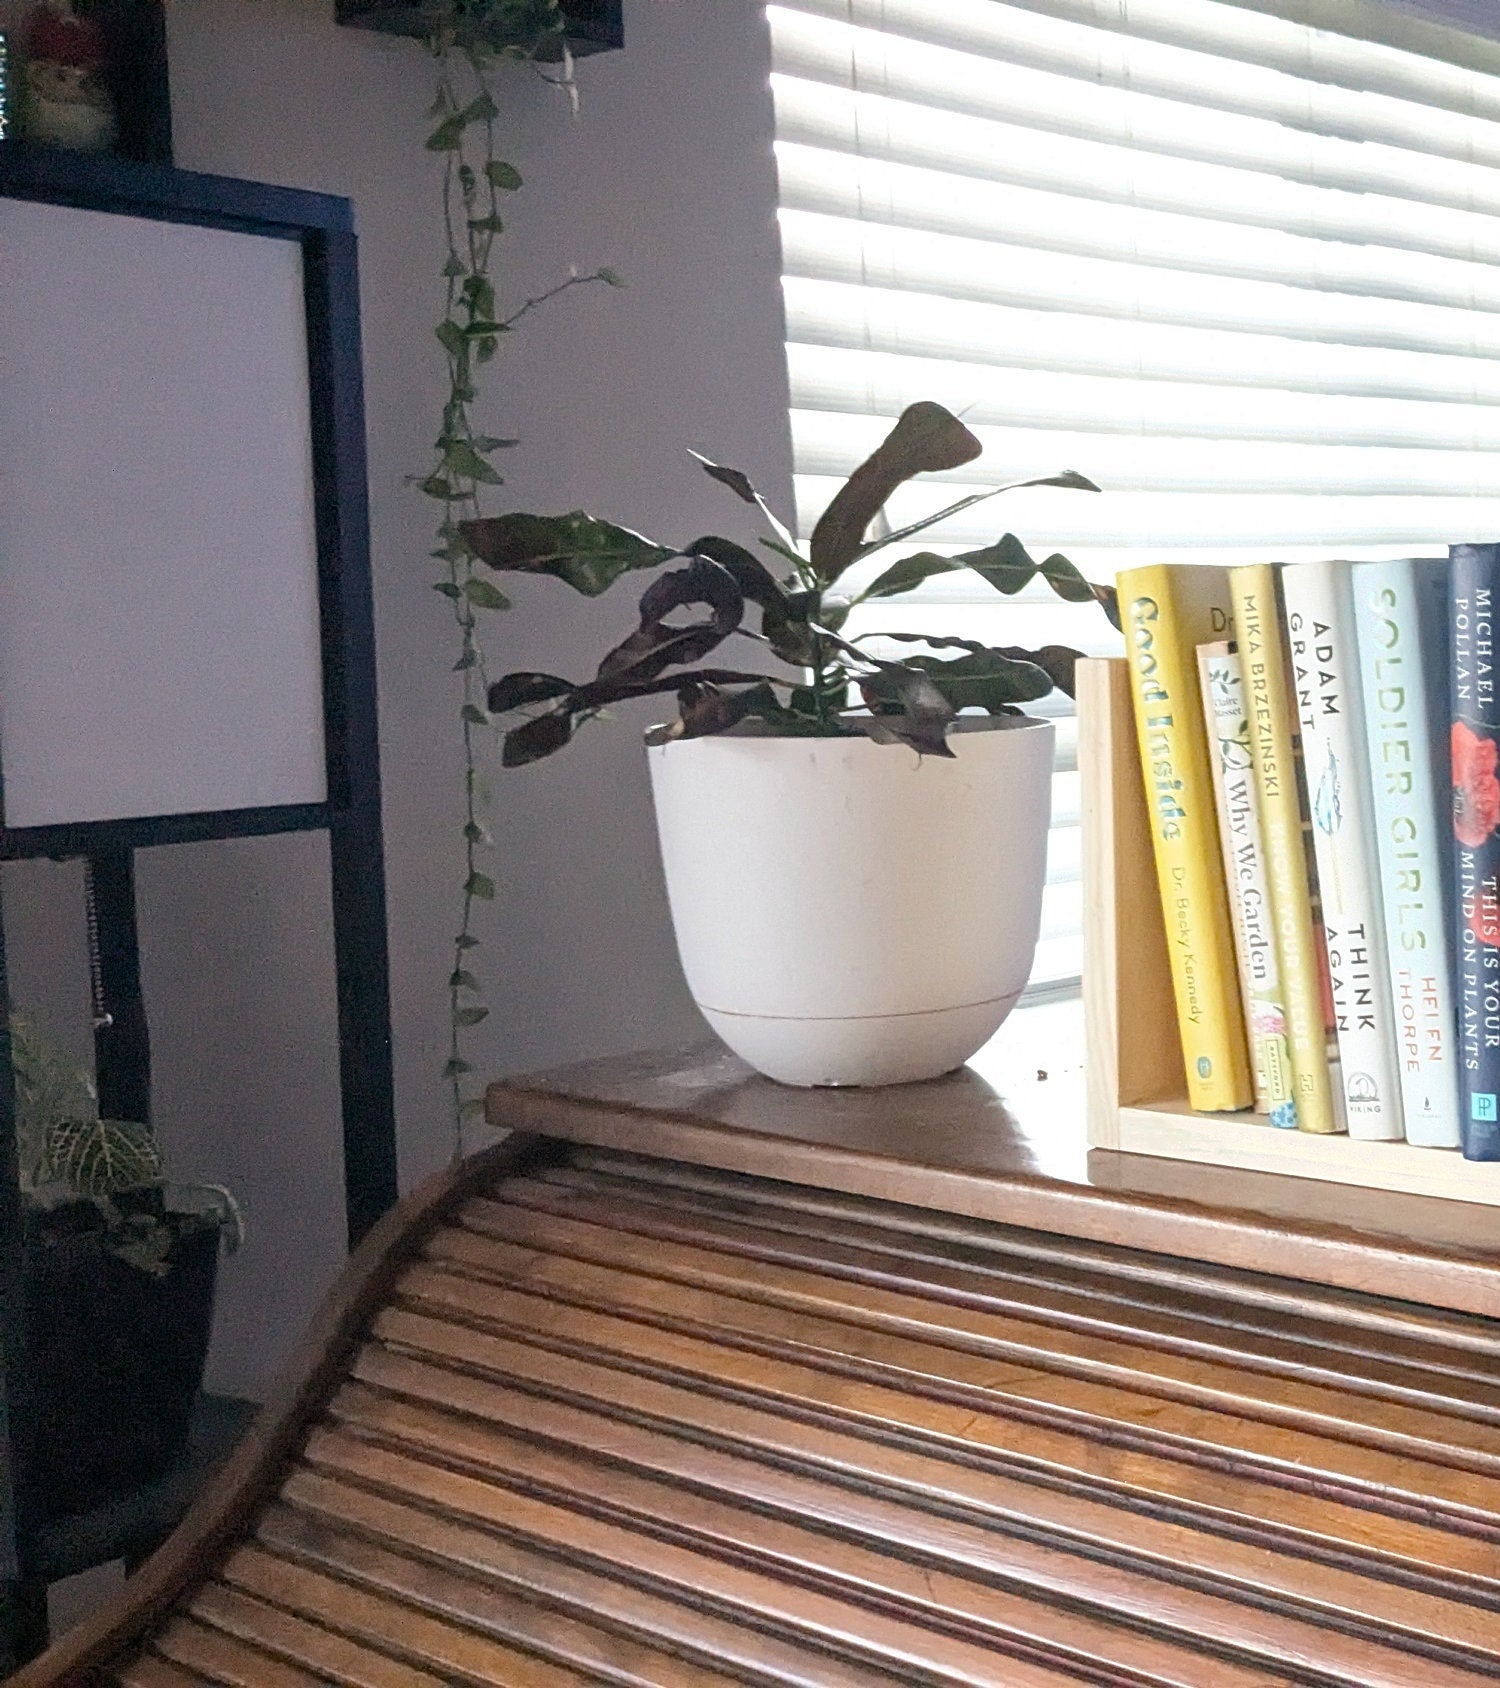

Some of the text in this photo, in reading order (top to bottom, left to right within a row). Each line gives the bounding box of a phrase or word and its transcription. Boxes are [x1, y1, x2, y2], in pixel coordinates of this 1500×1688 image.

[1244, 595, 1280, 797] MIKA BRZEZINSKI
[1290, 612, 1315, 730] GRANT
[1312, 621, 1341, 715] ADAM
[1456, 598, 1471, 700] POLLAN
[1475, 588, 1494, 710] MICHAEL
[1131, 597, 1187, 841] Good Inside
[1367, 587, 1427, 951] SOLDIER GIRLS
[1228, 780, 1251, 836] Why
[1237, 843, 1258, 881] We
[1171, 866, 1204, 1025] Dr. Becky Kennedy
[1243, 888, 1269, 979] Garden
[1326, 926, 1349, 1032] AGAIN
[1347, 923, 1376, 1030] THINK
[1461, 851, 1479, 1071] MIND ON PLANTS
[1481, 876, 1500, 1048] THIS IS YOUR
[1399, 969, 1420, 1073] THORPE
[1420, 977, 1443, 1061] HELEN
[1350, 1104, 1381, 1113] VIKING
